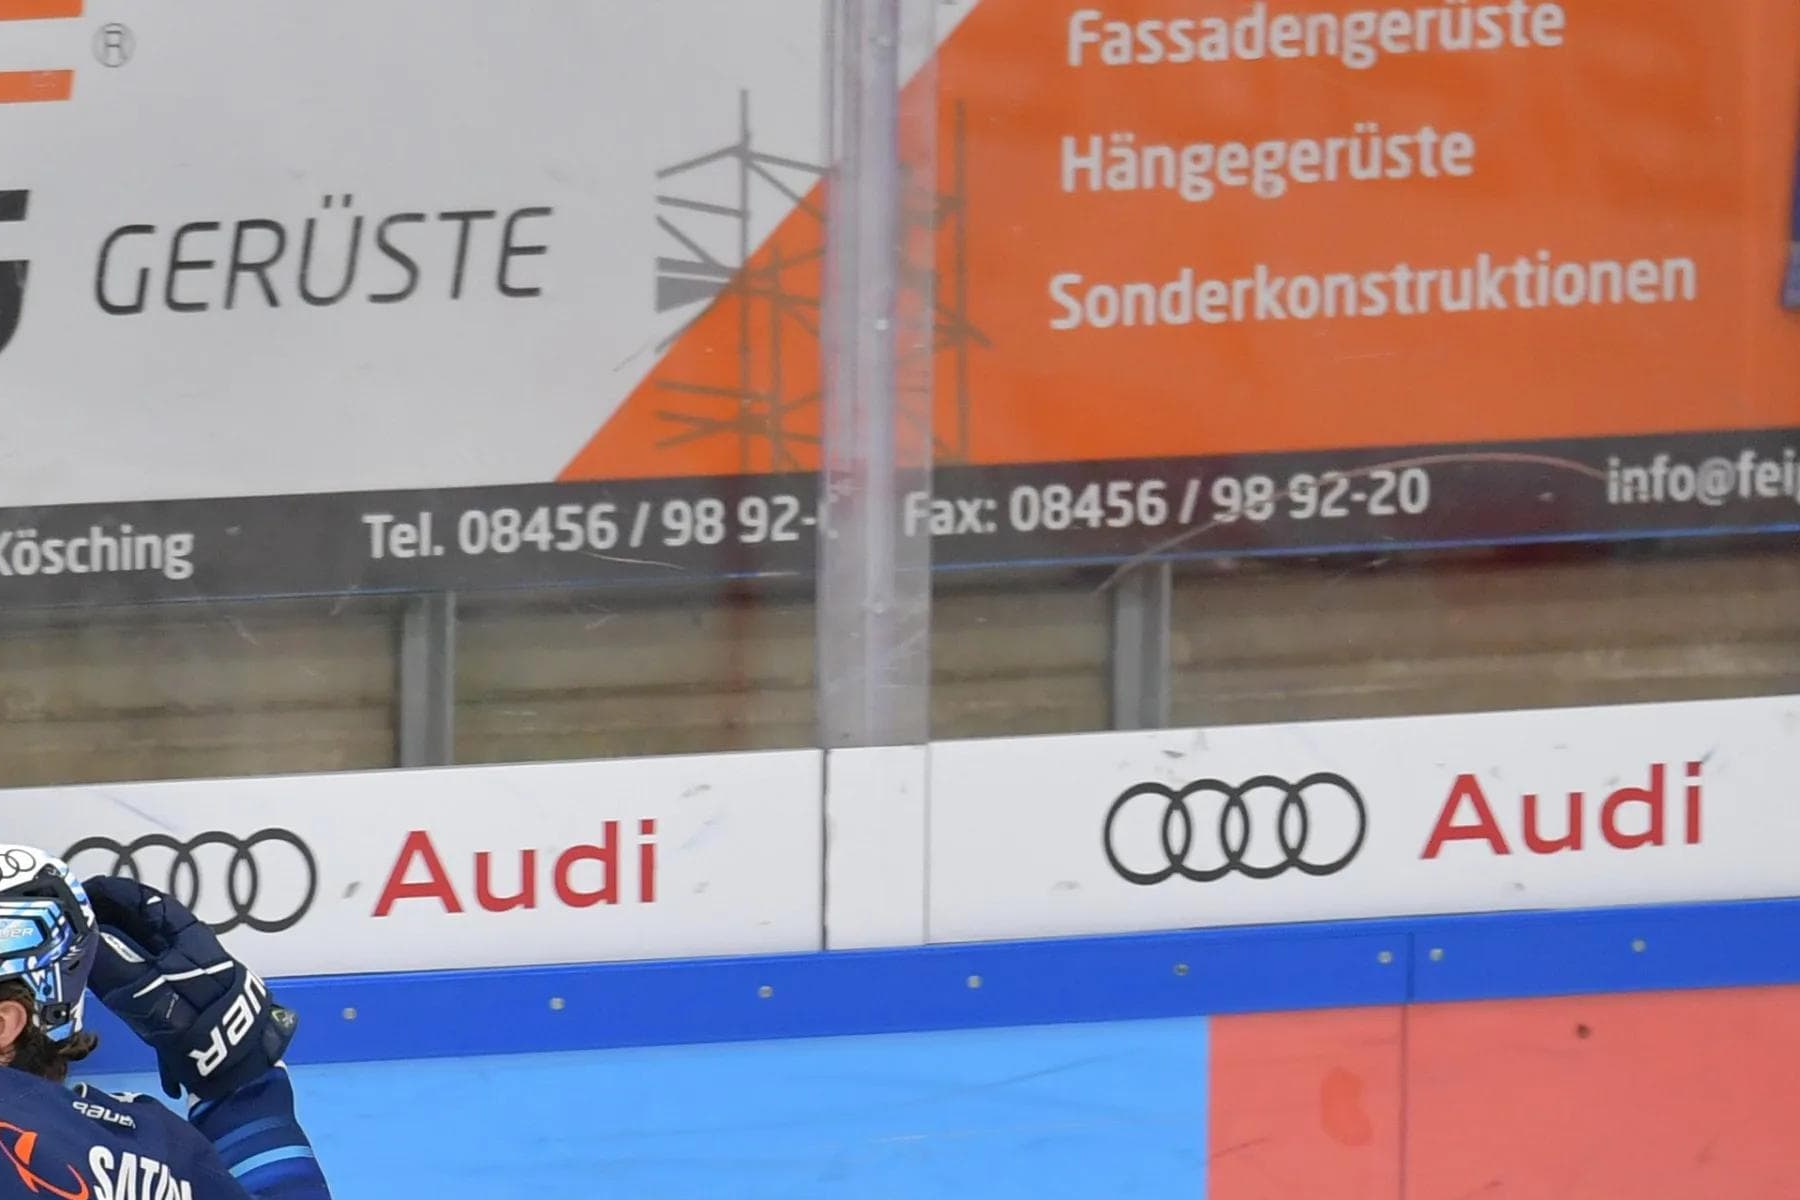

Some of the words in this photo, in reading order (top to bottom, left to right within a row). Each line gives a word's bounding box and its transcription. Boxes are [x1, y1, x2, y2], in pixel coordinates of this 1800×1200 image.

[1067, 1, 1566, 68] Fassadengerüste
[1061, 122, 1475, 201] Hängegerüste
[94, 194, 554, 315] GERÜSTE
[1049, 250, 1696, 330] Sonderkonstruktionen
[363, 512, 443, 559] Tel.
[457, 504, 619, 555] 08456
[661, 498, 725, 548] 98
[904, 491, 998, 537] Fax:
[1008, 479, 1169, 533] 08456
[1211, 474, 1275, 523] 98
[1289, 467, 1431, 519] 92-20
[1607, 448, 1800, 505] info@fei
[1419, 761, 1702, 860] Audi
[371, 819, 656, 918] Audi
